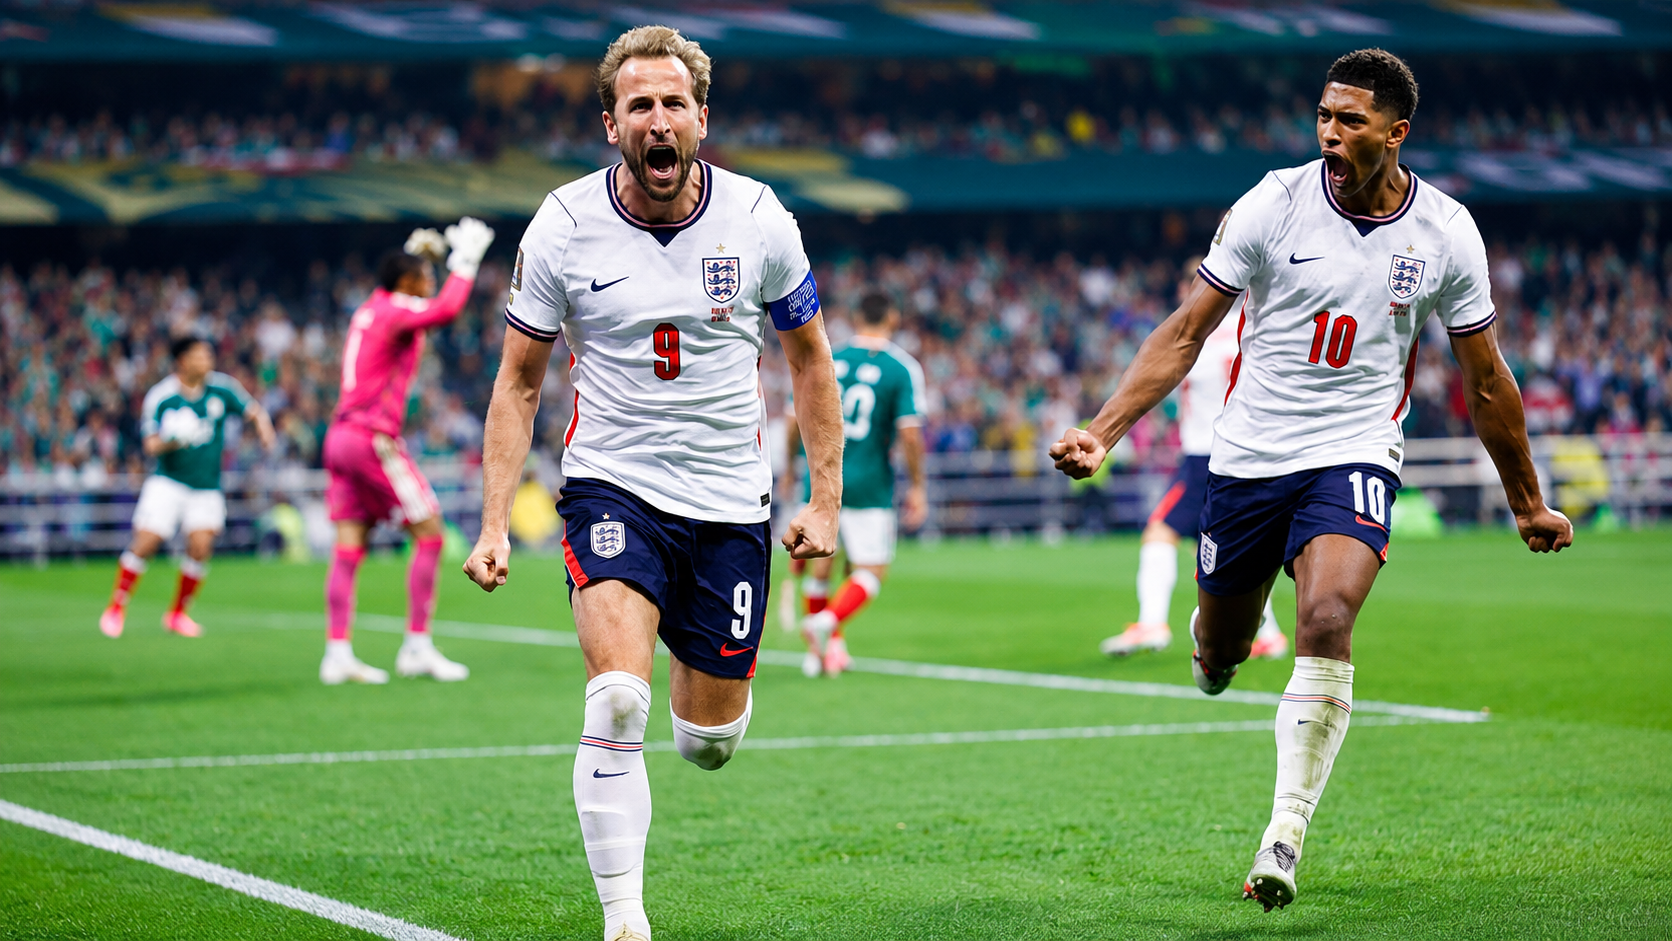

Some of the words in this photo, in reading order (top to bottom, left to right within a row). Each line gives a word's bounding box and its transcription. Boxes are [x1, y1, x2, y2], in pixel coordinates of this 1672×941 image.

[653, 323, 681, 380] 9
[1308, 310, 1358, 369] 10
[838, 382, 877, 441] 0
[1349, 471, 1386, 525] 10
[731, 582, 753, 640] 9
